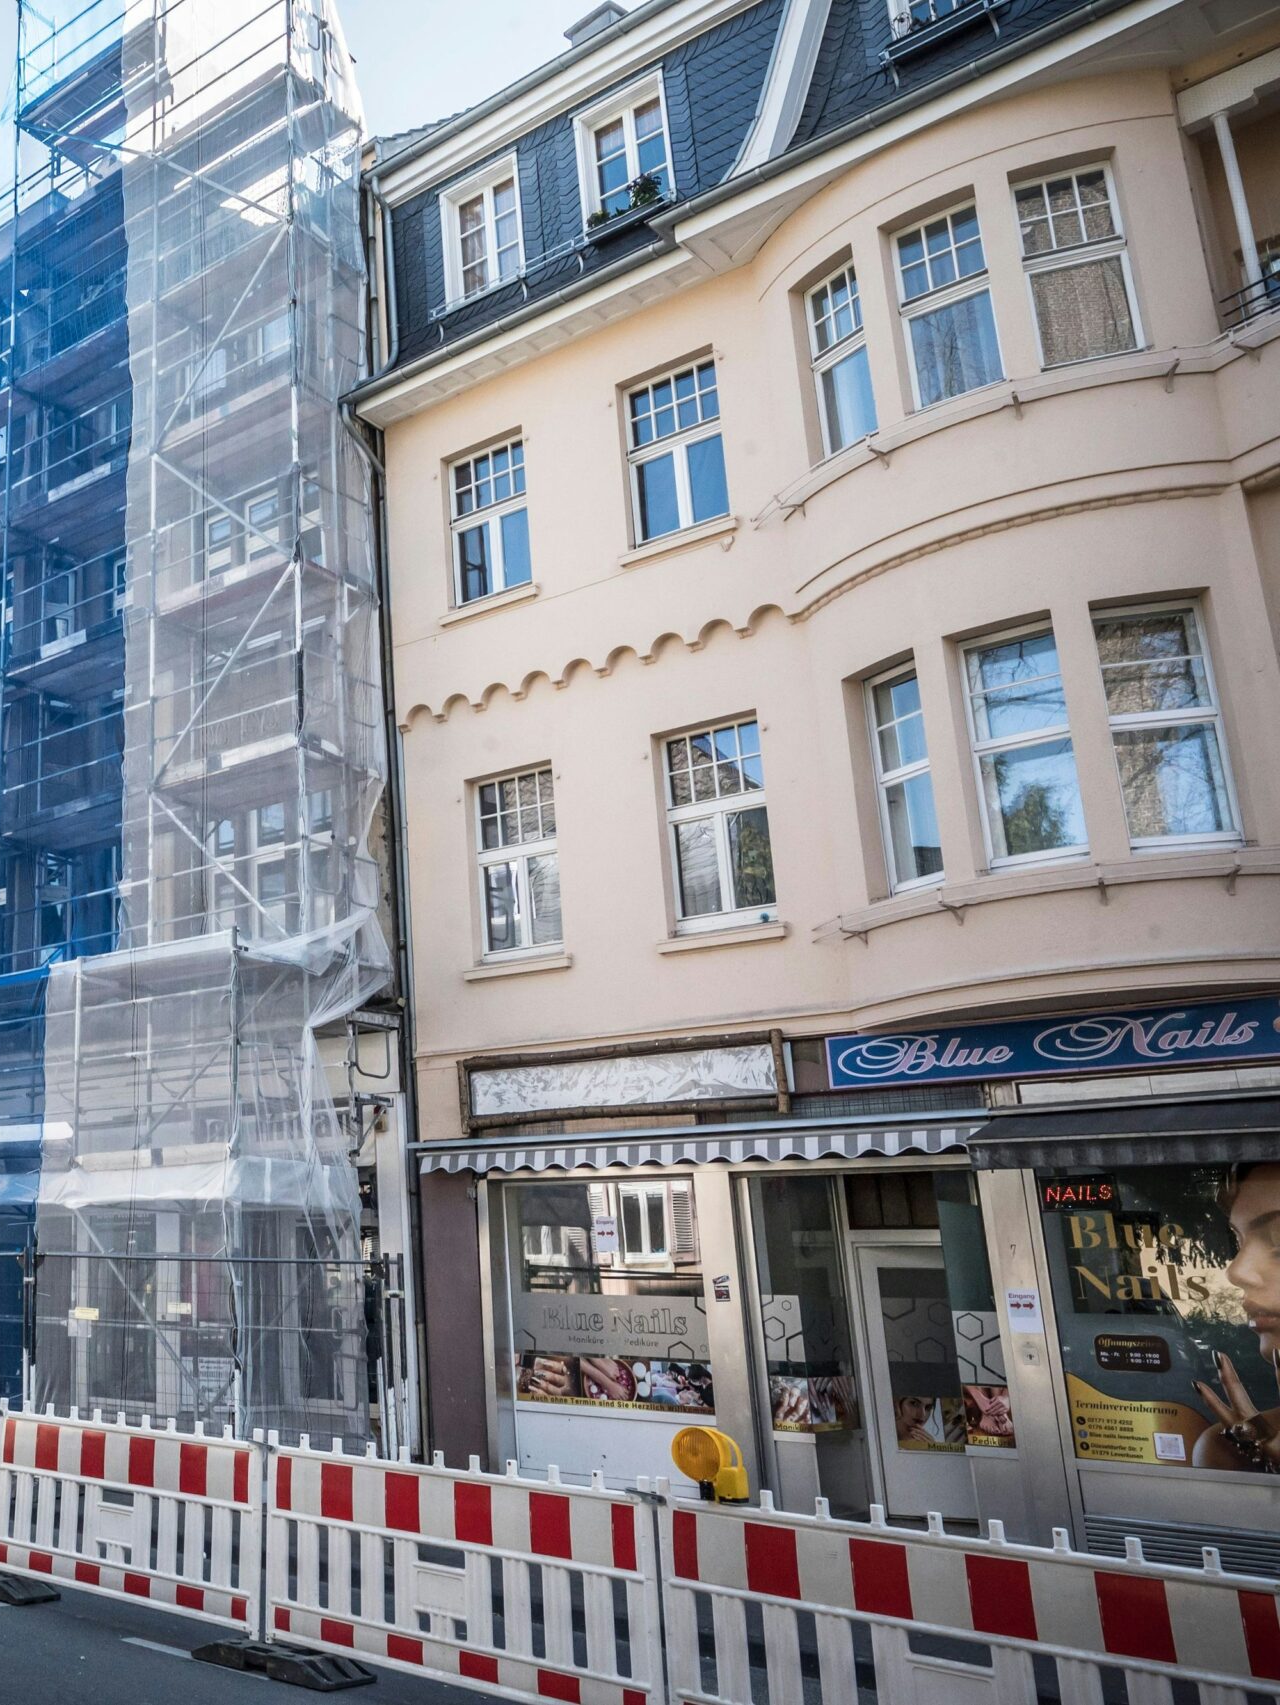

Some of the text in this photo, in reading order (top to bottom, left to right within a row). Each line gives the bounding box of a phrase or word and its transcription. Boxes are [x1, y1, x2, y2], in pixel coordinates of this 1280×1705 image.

[837, 1011, 1261, 1078] Blue Nails
[1045, 1184, 1113, 1203] NAILS
[1065, 1212, 1186, 1250] Blue
[1010, 1243, 1017, 1257] 7
[1074, 1262, 1211, 1301] Nails
[1008, 1292, 1036, 1300] Eingang
[542, 1304, 689, 1336] Blue Nails
[570, 1397, 596, 1406] Termin
[599, 1399, 615, 1408] sind
[617, 1401, 629, 1409] Sie
[631, 1402, 664, 1412] Herzlich
[1075, 1399, 1178, 1416] Terminvereinbarung
